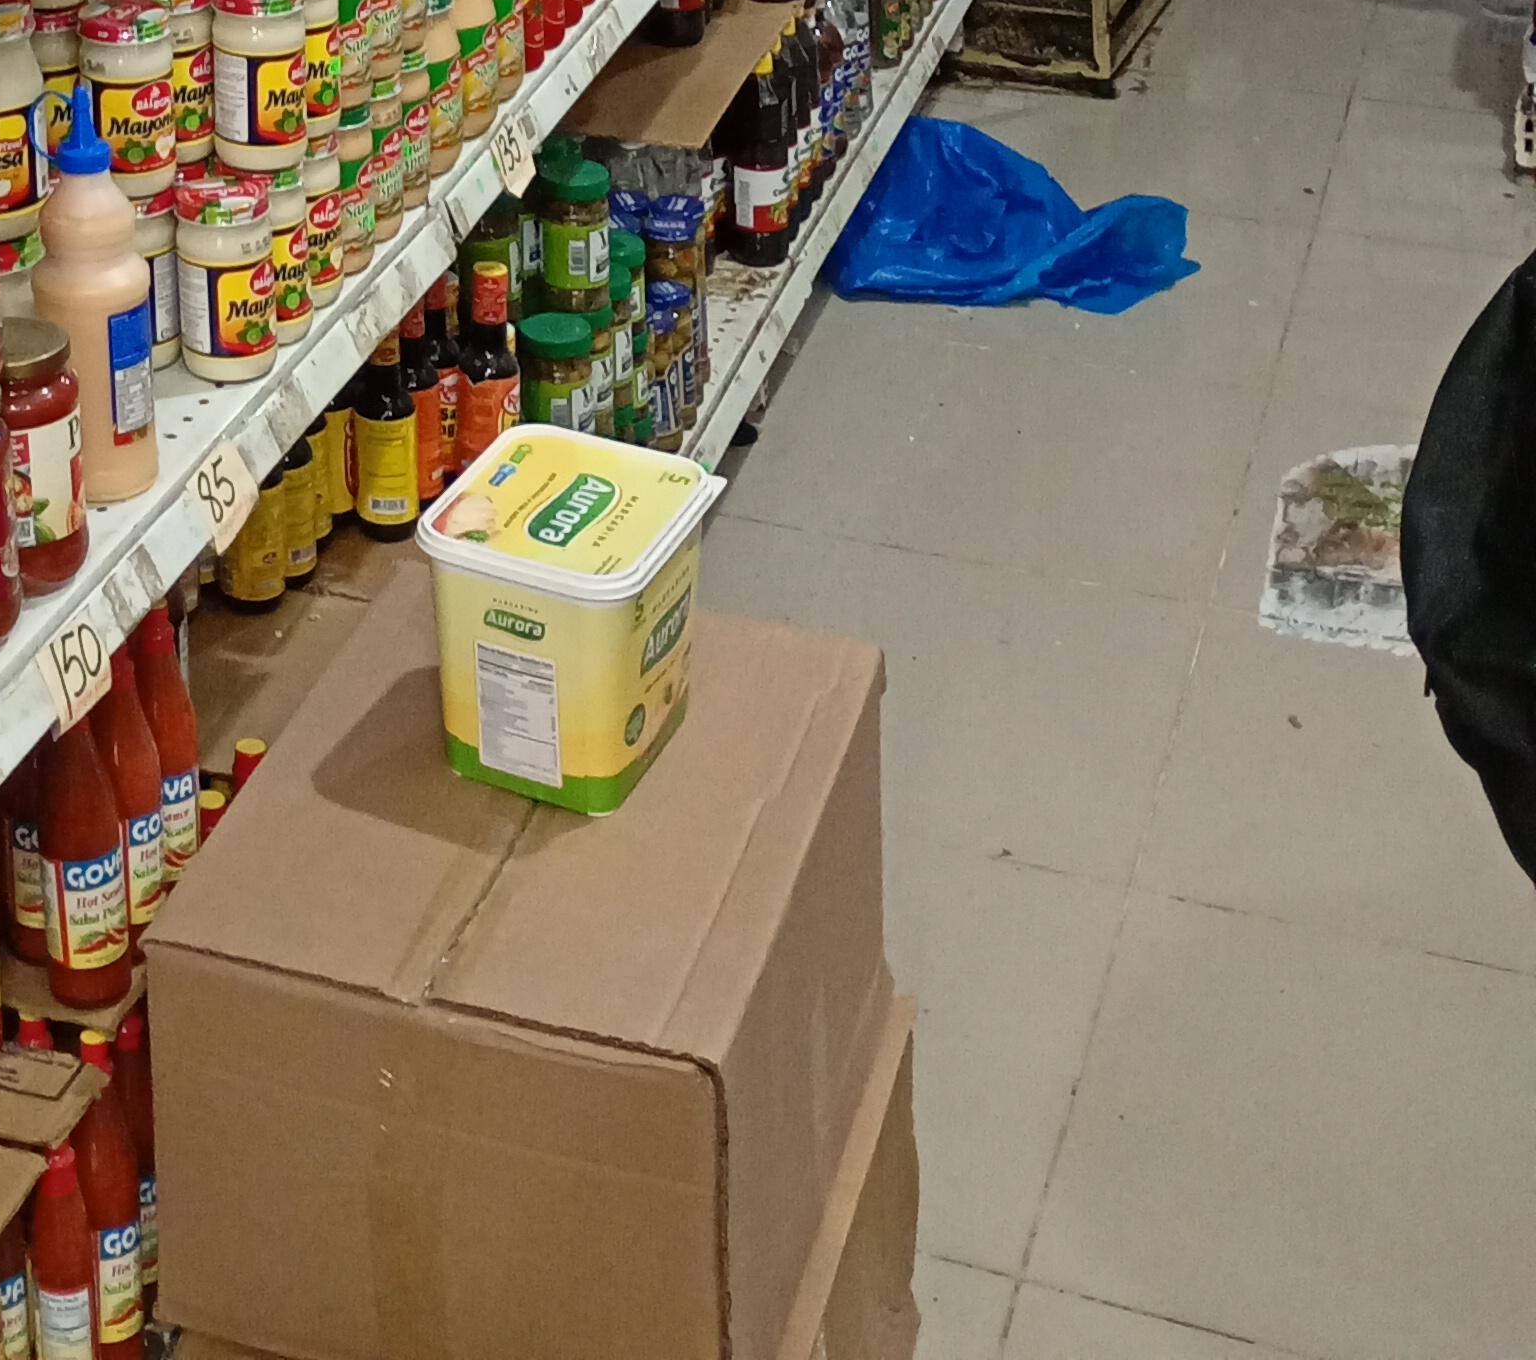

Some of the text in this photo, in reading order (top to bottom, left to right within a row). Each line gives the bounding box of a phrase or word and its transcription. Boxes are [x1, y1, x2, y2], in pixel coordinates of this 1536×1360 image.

[493, 127, 523, 177] 135
[197, 455, 237, 525] 85
[538, 475, 617, 544] Aurora
[485, 610, 544, 639] Aurora
[50, 622, 102, 720] 150
